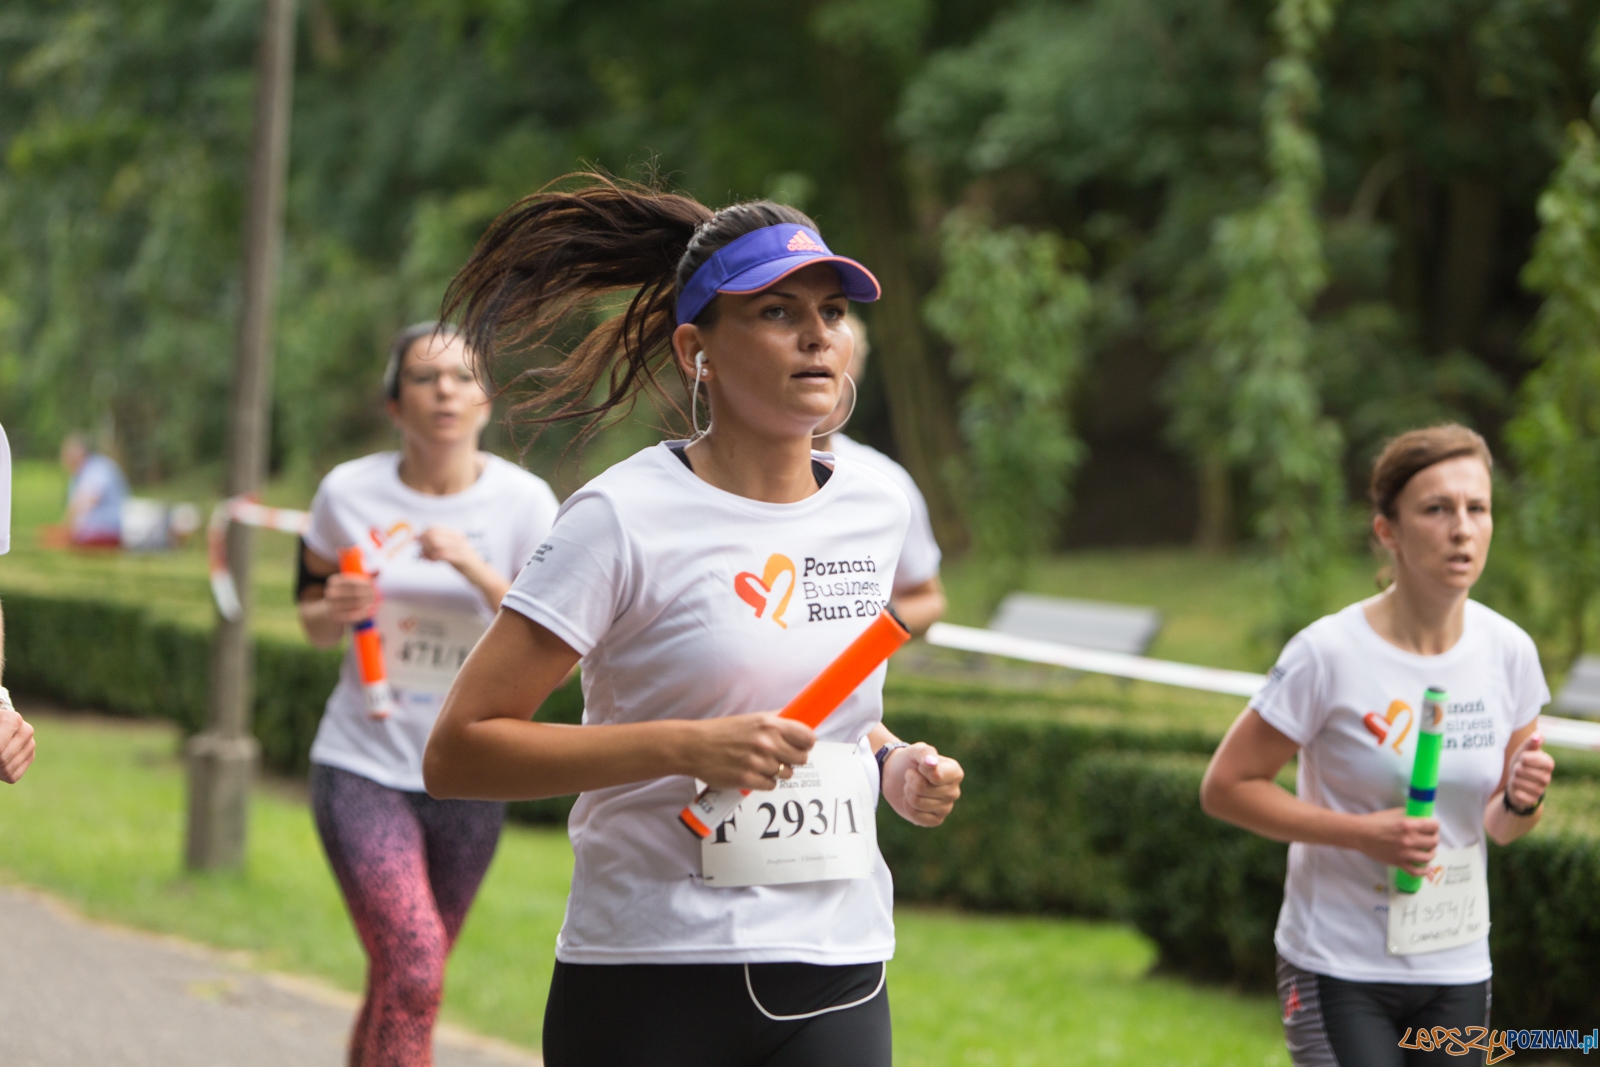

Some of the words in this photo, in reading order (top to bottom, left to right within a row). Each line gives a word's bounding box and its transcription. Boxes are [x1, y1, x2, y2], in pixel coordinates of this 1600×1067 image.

[803, 555, 876, 577] Poznań
[803, 578, 882, 600] Business
[807, 602, 852, 622] Run
[1446, 717, 1494, 732] siness
[757, 798, 860, 840] 293/1
